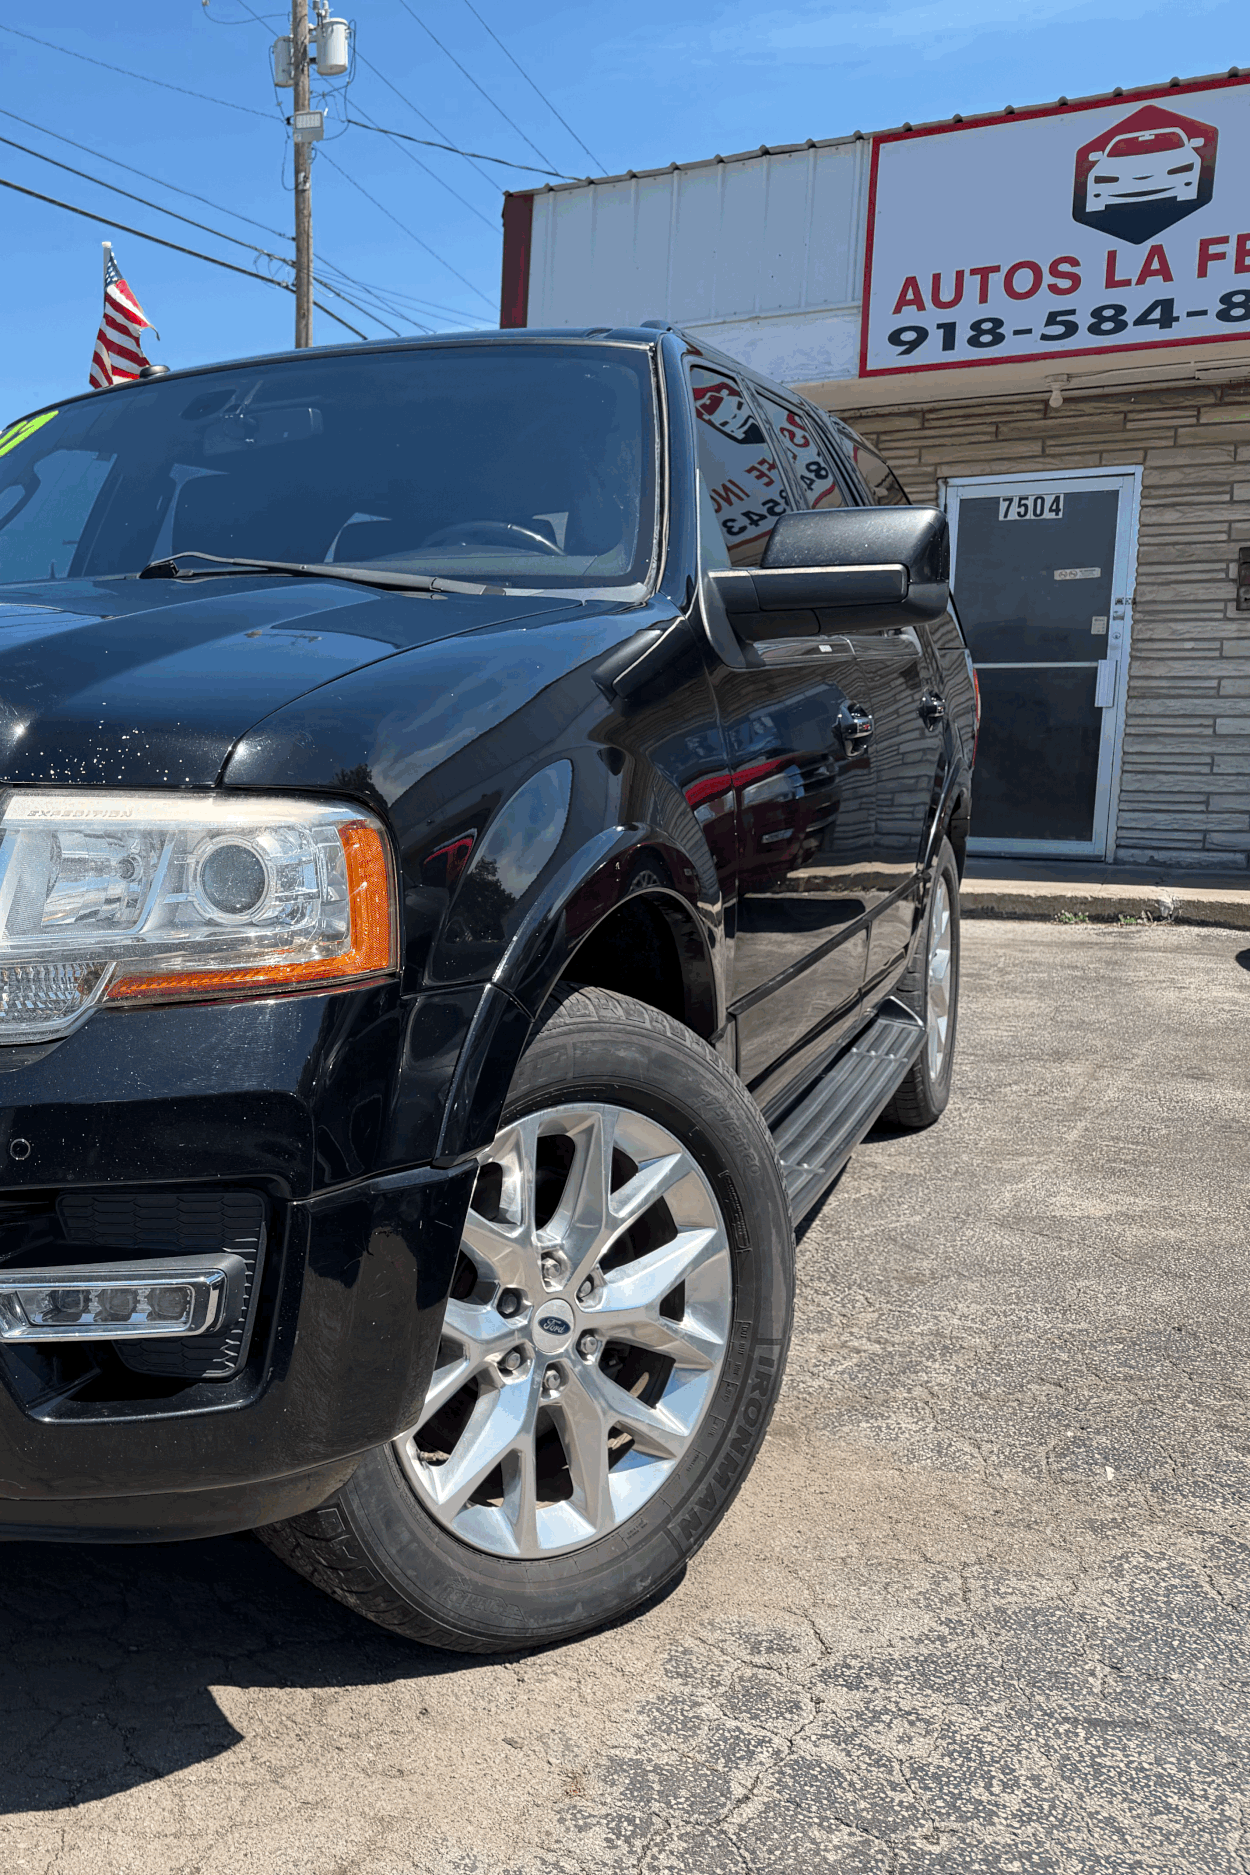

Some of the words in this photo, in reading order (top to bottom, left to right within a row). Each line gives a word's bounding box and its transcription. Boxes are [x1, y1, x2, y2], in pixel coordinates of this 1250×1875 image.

[892, 256, 1082, 315] AUTOS
[1104, 244, 1174, 289] LA
[1196, 233, 1250, 279] FE
[1002, 495, 1062, 519] 7504
[26, 809, 133, 818] EXPEDITION
[543, 1318, 566, 1334] Ford
[677, 1355, 776, 1545] IRONMAN
